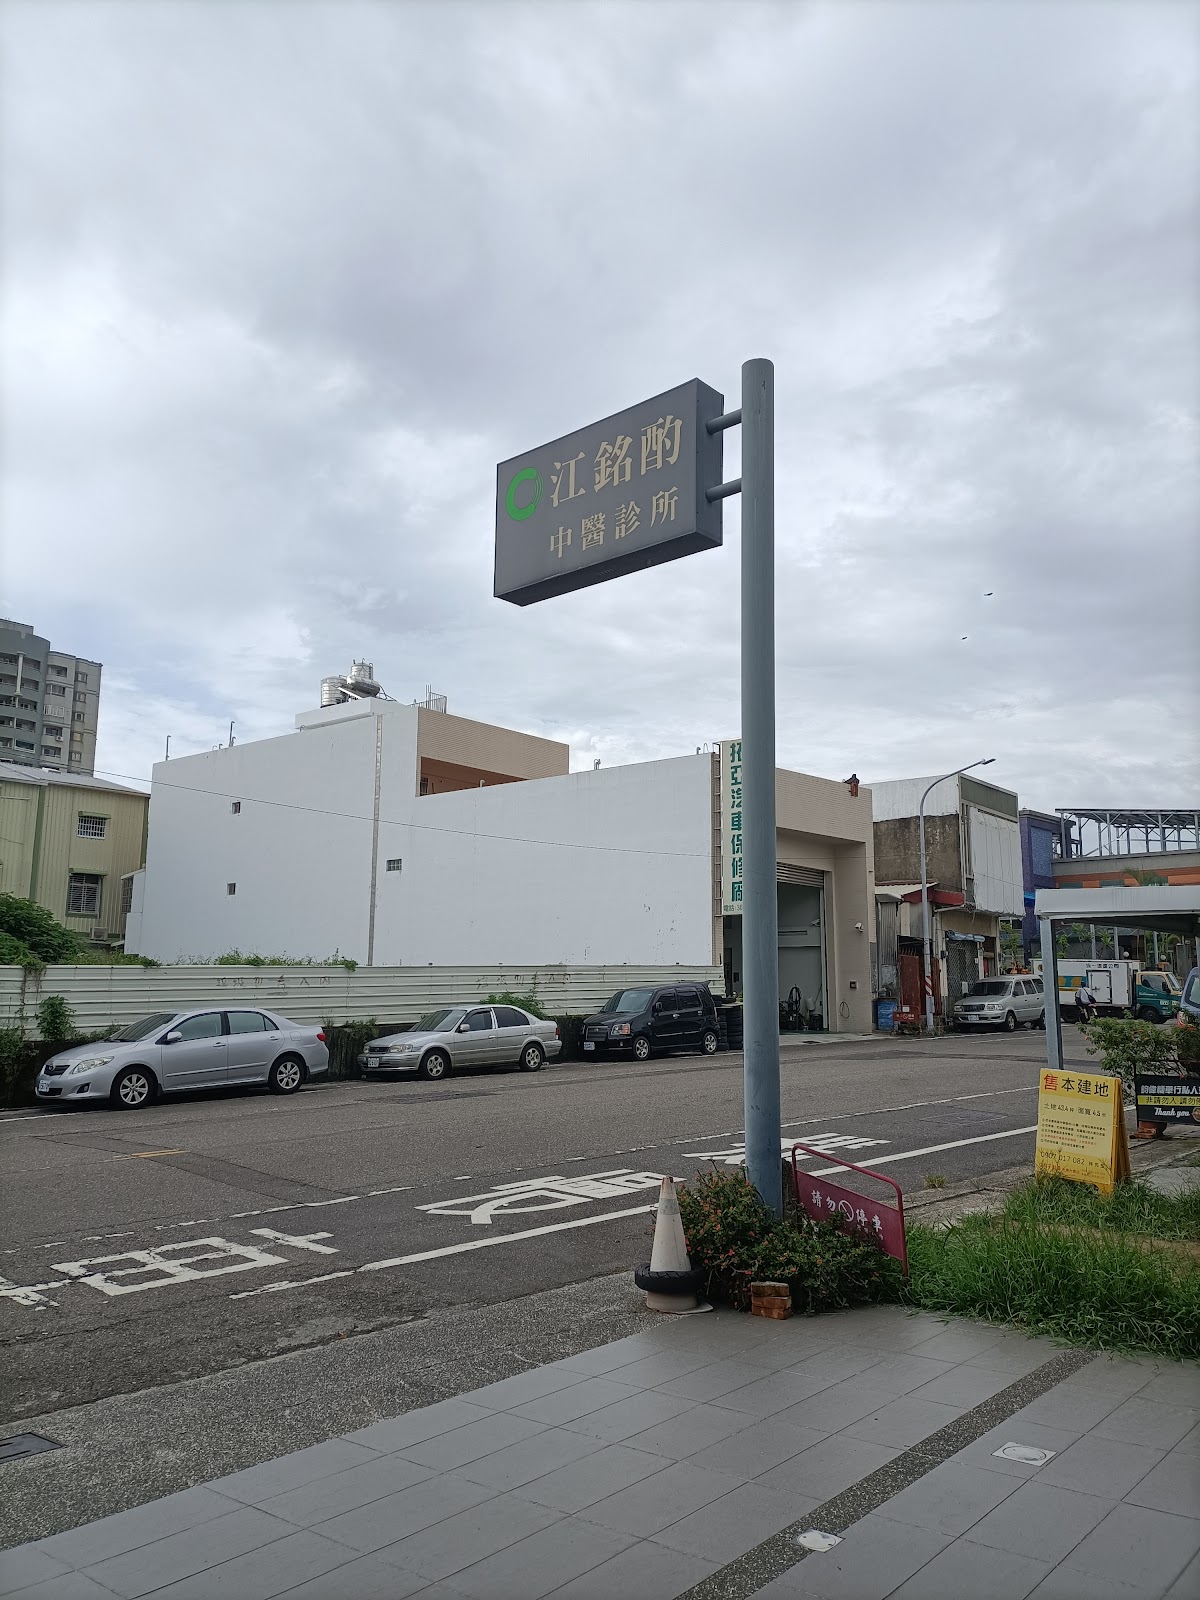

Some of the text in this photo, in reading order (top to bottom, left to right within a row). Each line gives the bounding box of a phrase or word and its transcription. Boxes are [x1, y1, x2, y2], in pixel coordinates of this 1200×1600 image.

[550, 415, 683, 508] 江銘酌
[550, 486, 678, 559] 中醫診所
[1043, 1073, 1109, 1097] 售本建地
[1154, 1107, 1190, 1118] Thank you
